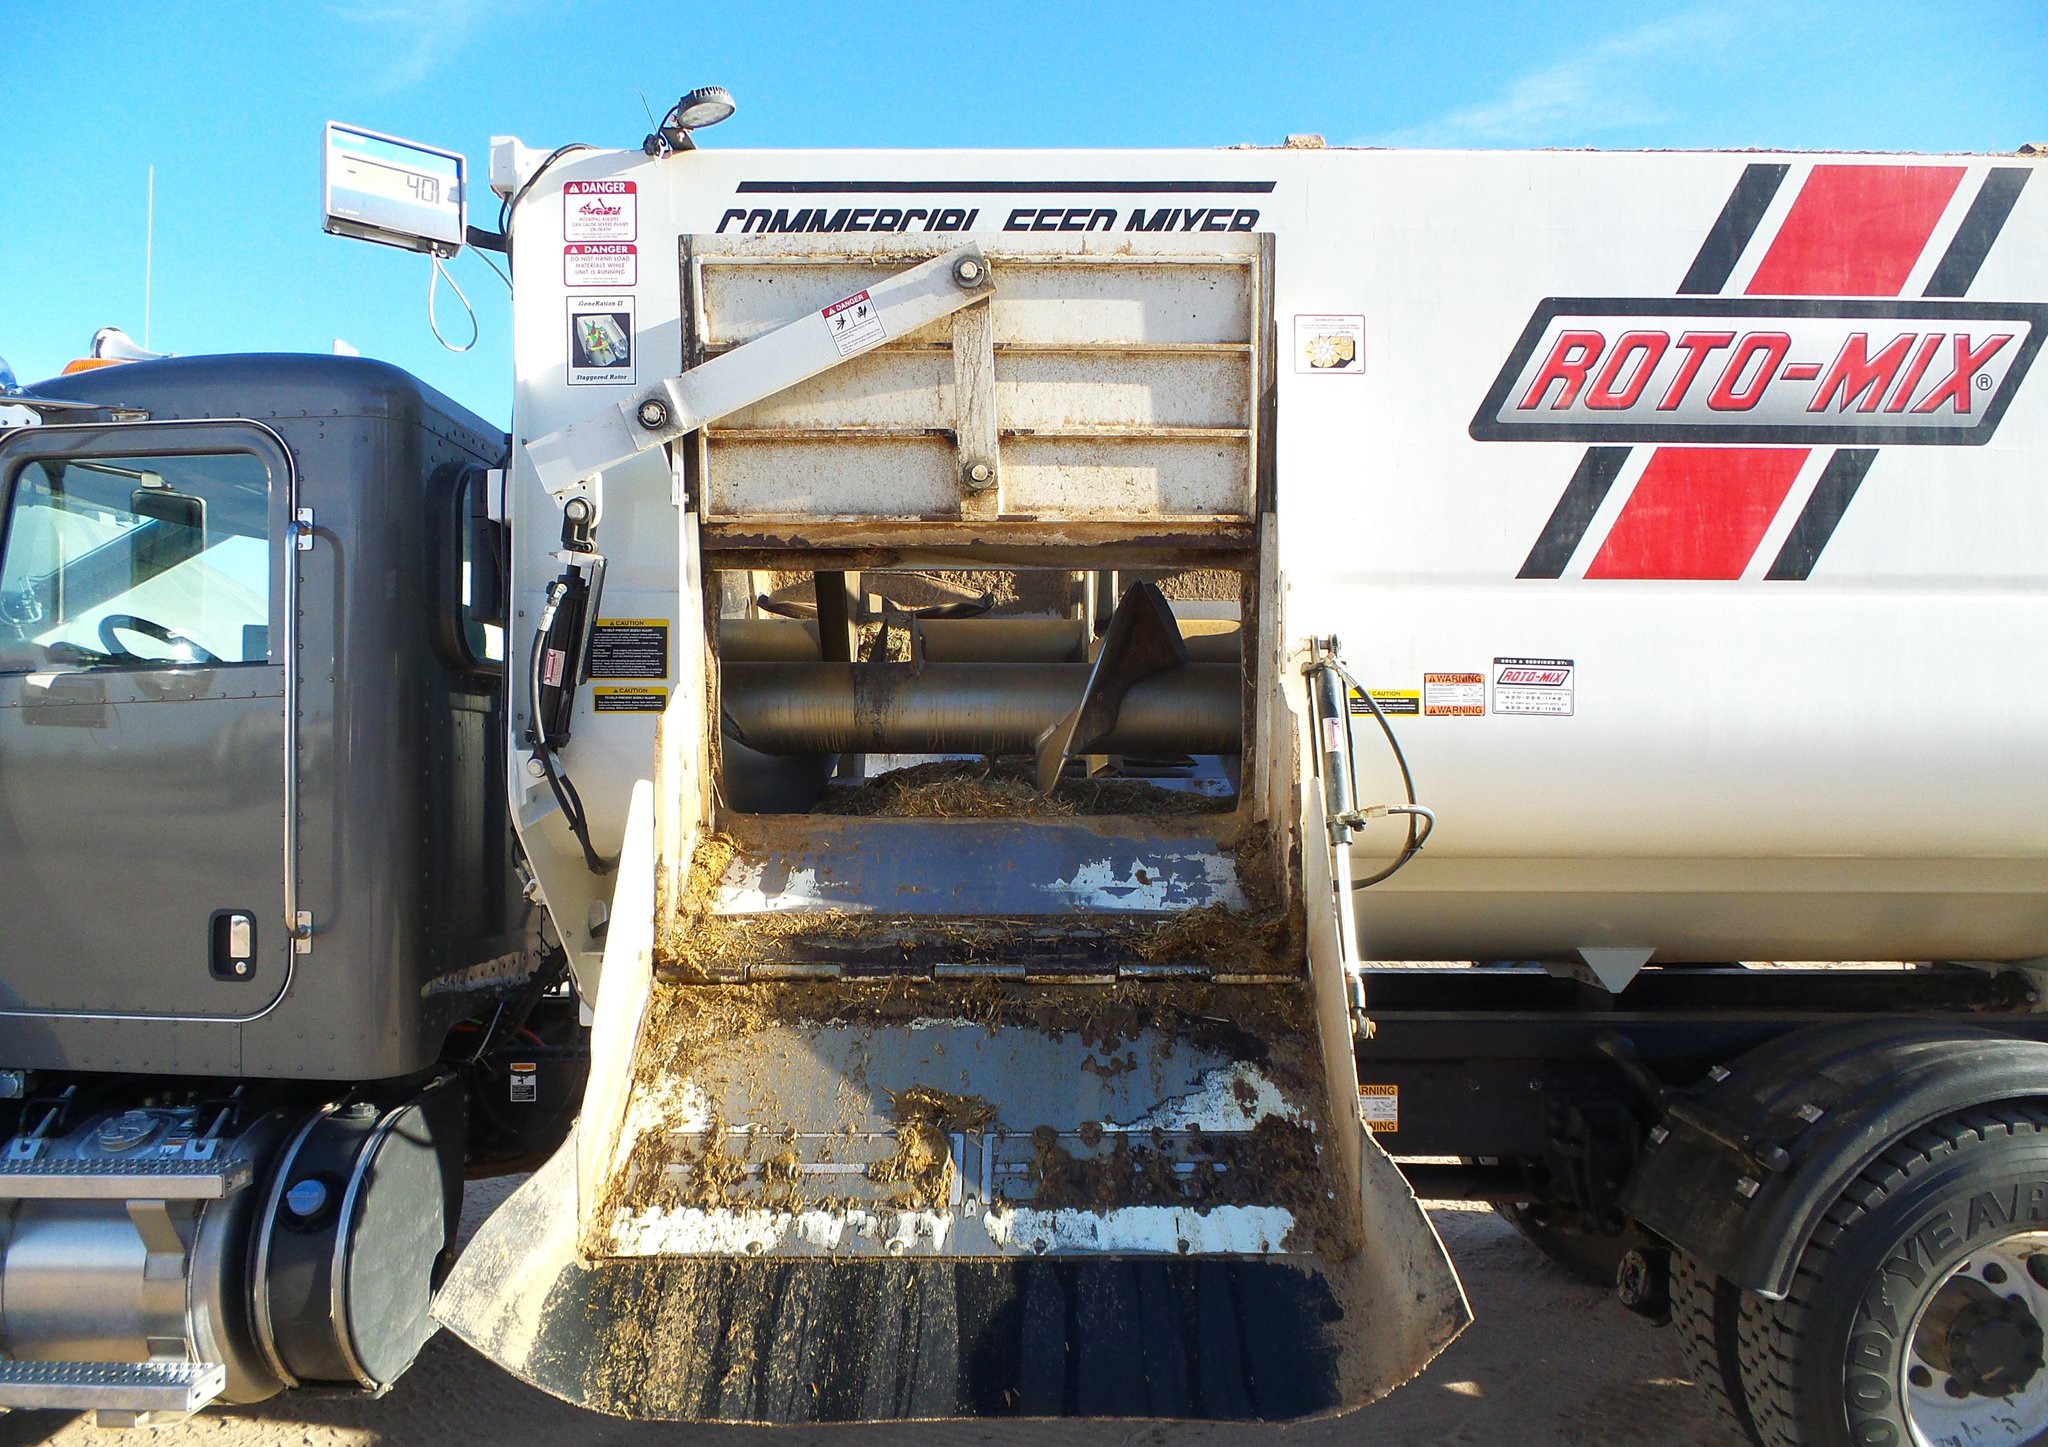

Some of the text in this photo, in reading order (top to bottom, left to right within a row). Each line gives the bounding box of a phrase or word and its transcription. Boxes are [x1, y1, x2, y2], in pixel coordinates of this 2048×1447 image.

[582, 182, 626, 193] DANGER
[584, 245, 628, 254] DANGER
[835, 294, 864, 311] DANGER
[1437, 675, 1482, 683] WARNING
[1502, 671, 1564, 683] ROTO-MIX
[1437, 705, 1482, 714] WARNING
[1360, 1086, 1395, 1096] RNING
